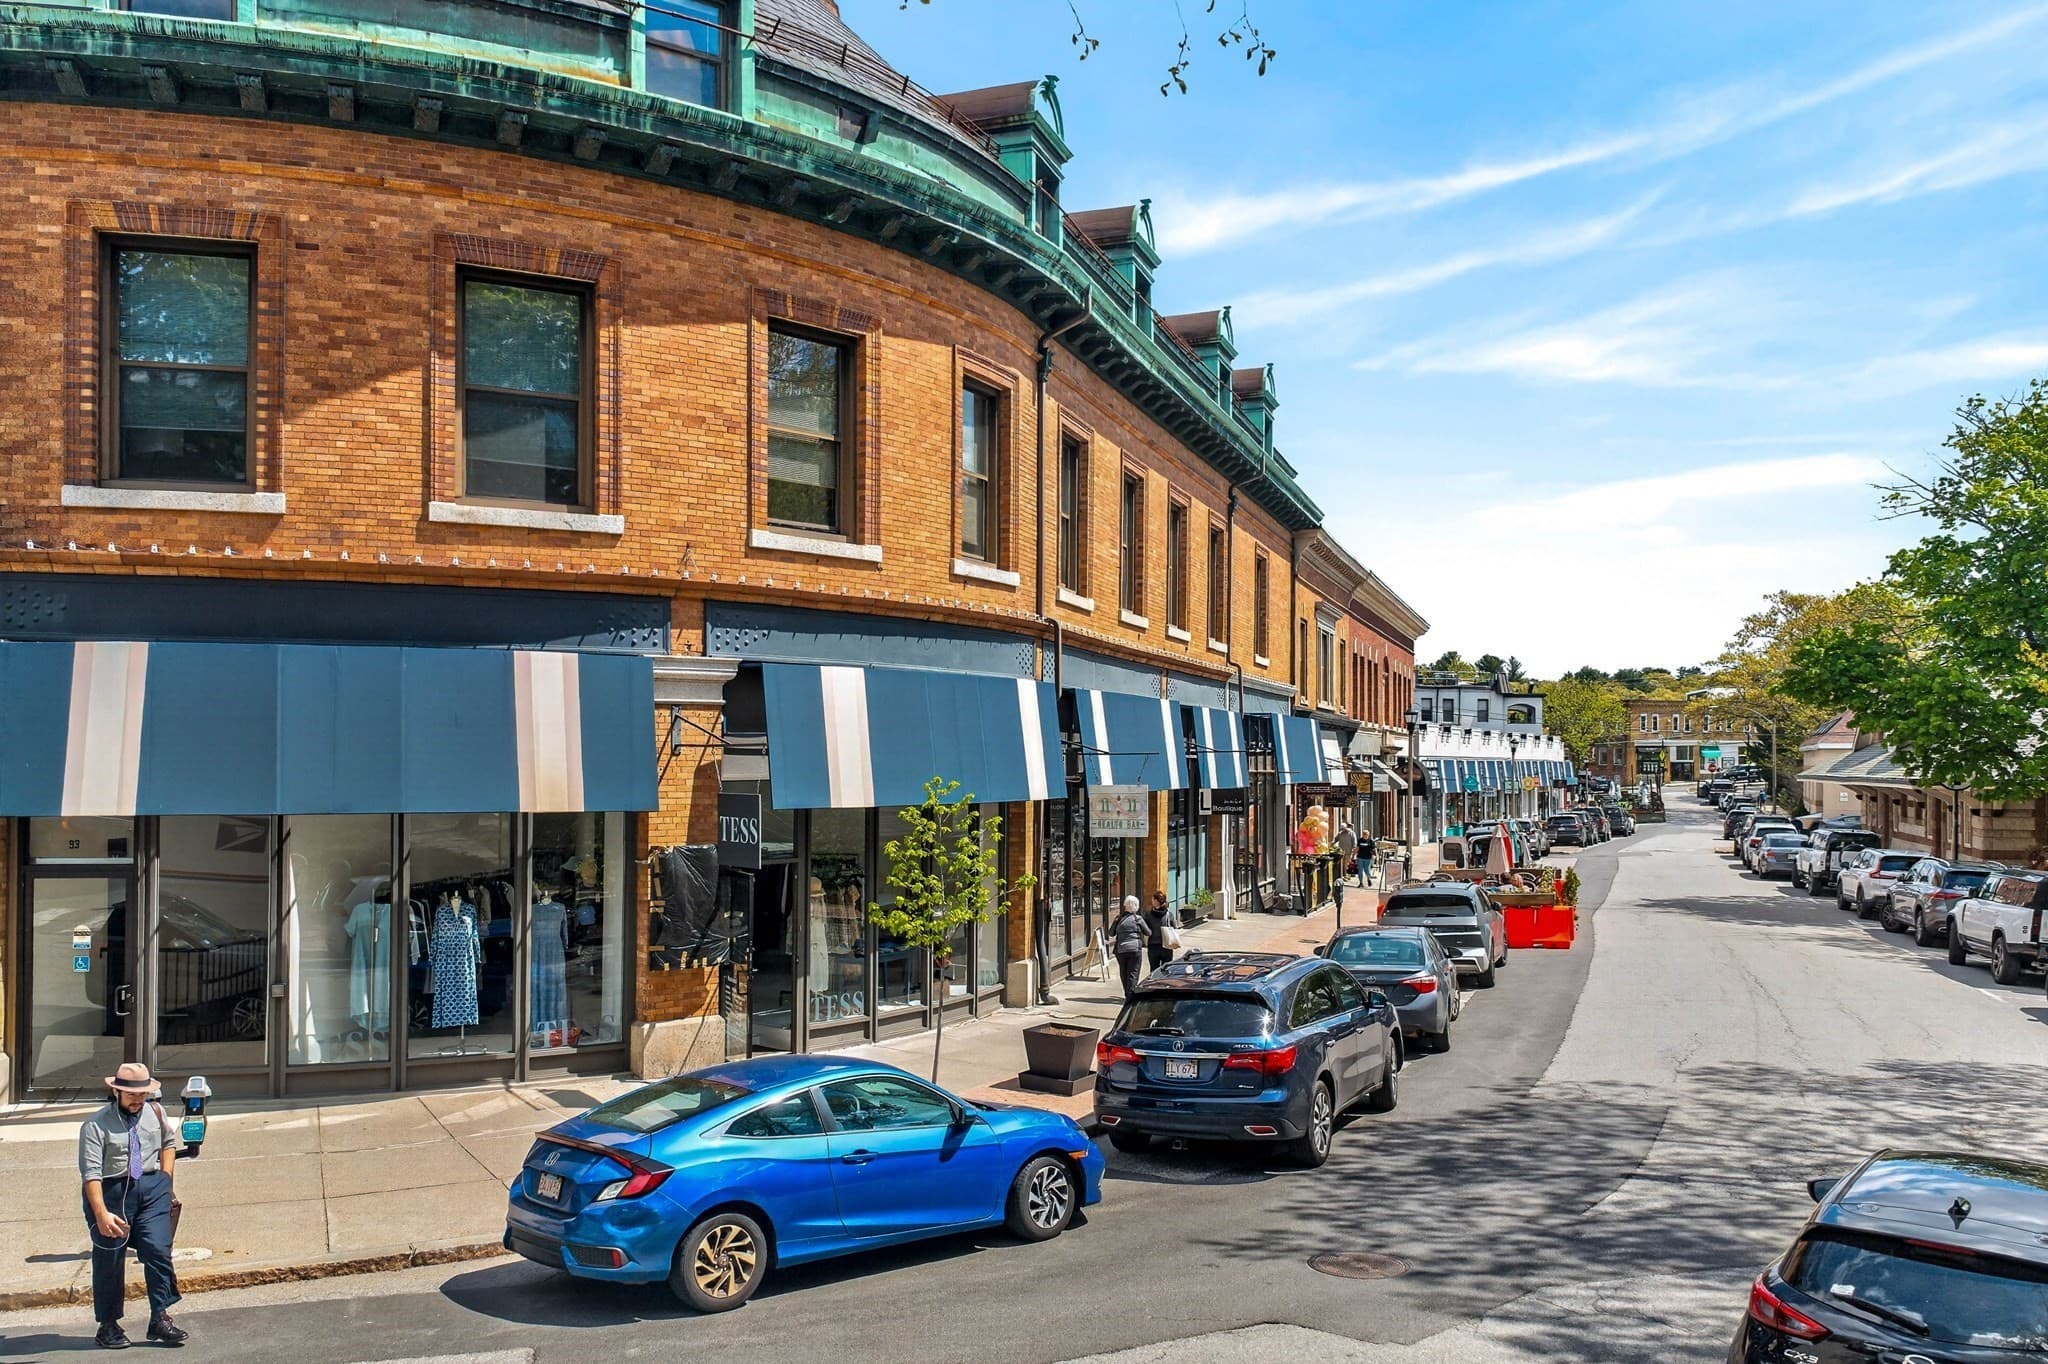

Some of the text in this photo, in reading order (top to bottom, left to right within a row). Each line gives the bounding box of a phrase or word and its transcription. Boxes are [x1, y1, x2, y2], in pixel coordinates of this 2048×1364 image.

[719, 815, 758, 845] TESS
[68, 839, 81, 849] 93
[810, 990, 864, 1022] TESS
[1783, 1348, 1819, 1364] CX-3
